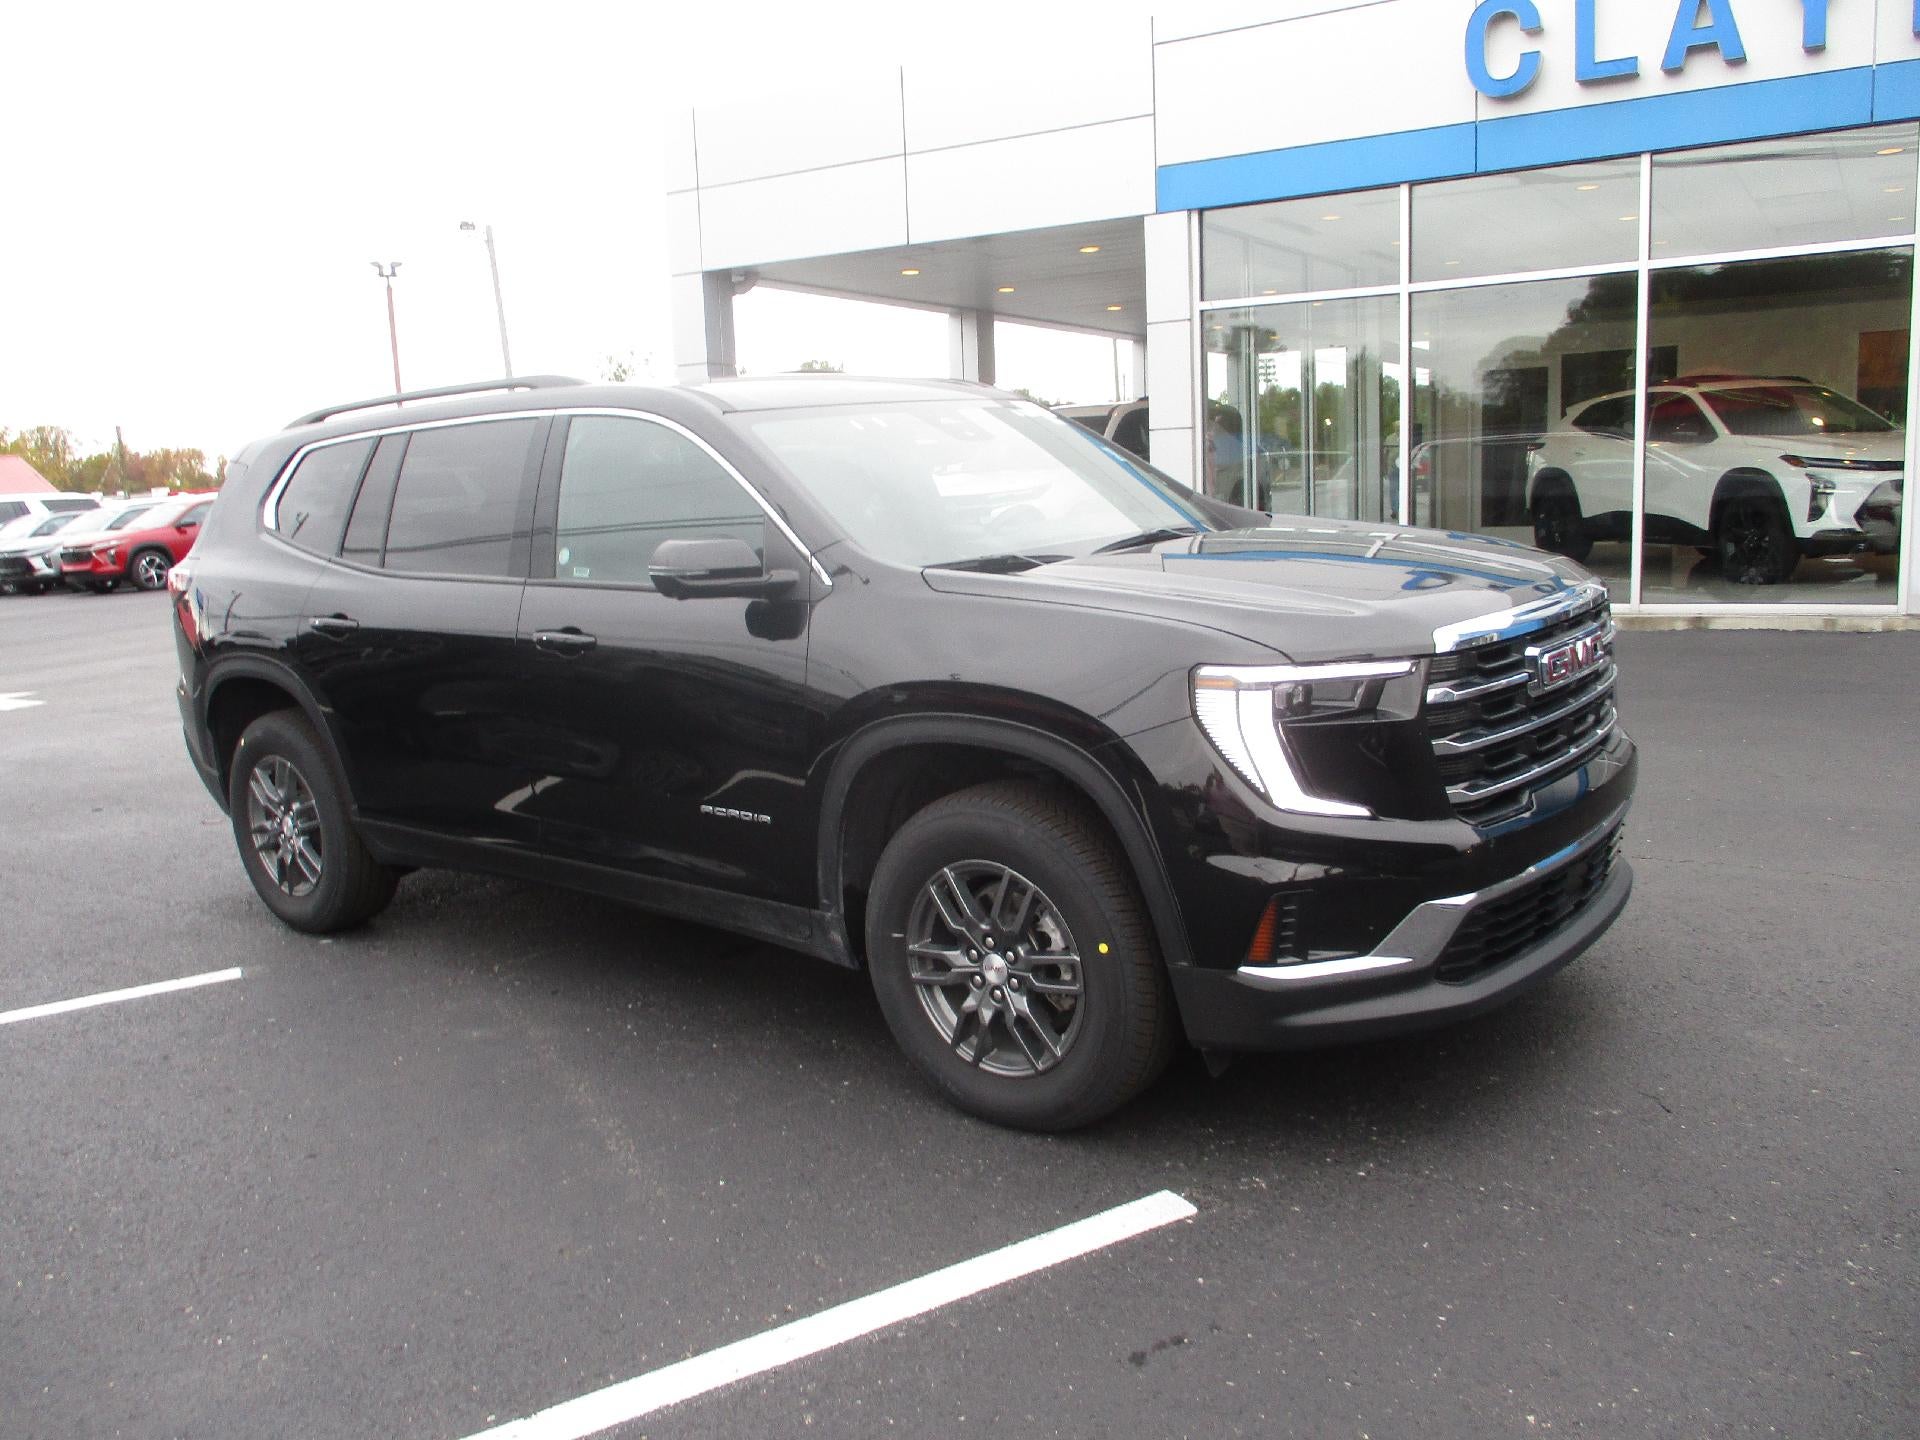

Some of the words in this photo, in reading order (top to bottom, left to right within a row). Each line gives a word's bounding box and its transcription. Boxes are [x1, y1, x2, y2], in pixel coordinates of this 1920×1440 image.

[1465, 0, 1920, 98] CLA
[1542, 632, 1605, 684] GMC
[700, 804, 771, 824] ACADIA
